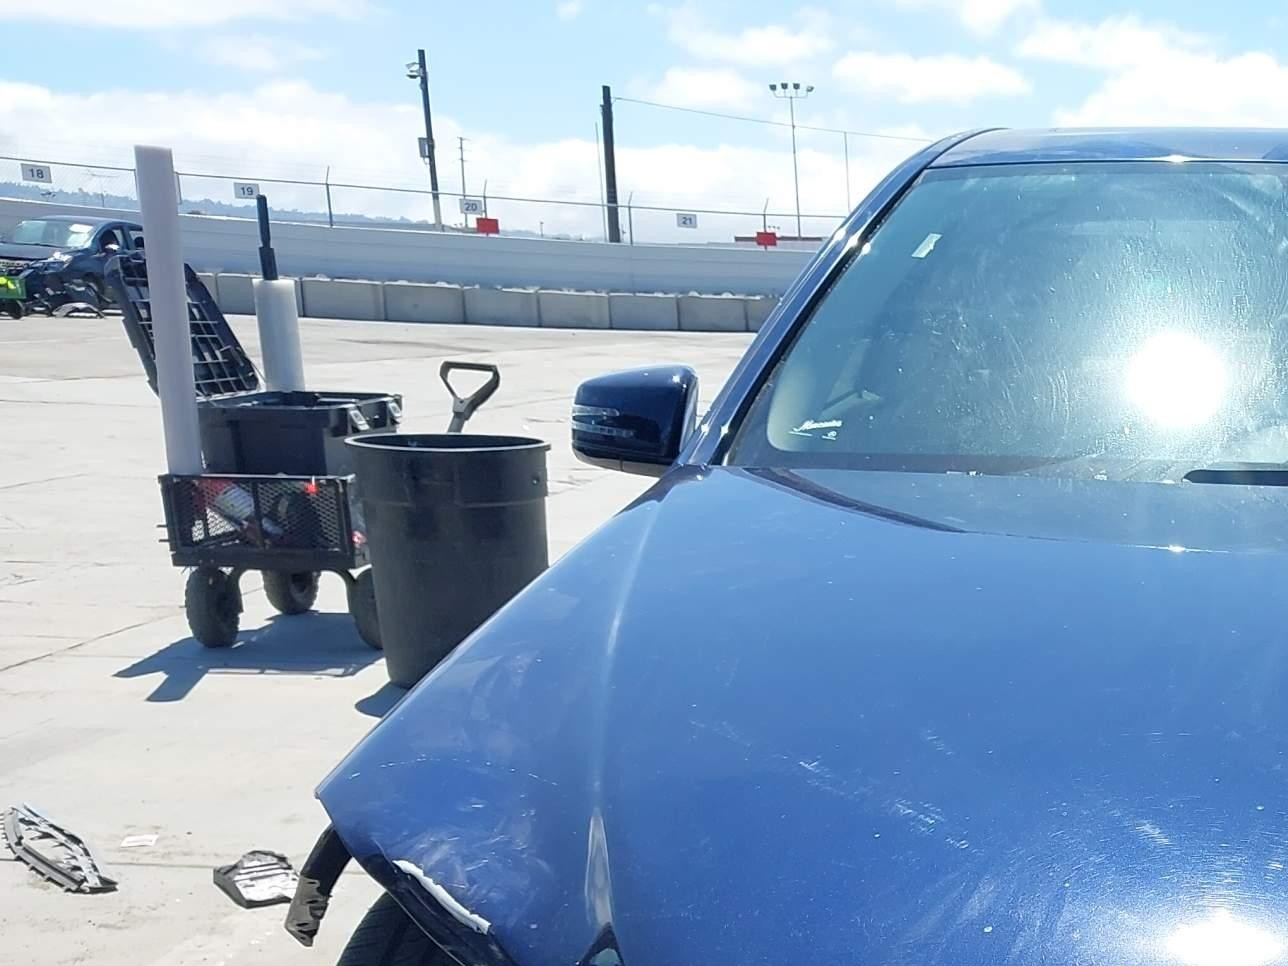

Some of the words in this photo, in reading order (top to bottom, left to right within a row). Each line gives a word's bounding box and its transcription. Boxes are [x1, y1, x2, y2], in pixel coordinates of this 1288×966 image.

[29, 168, 45, 179] 18
[240, 186, 254, 196] 19
[464, 202, 478, 212] 20
[682, 216, 693, 225] 21
